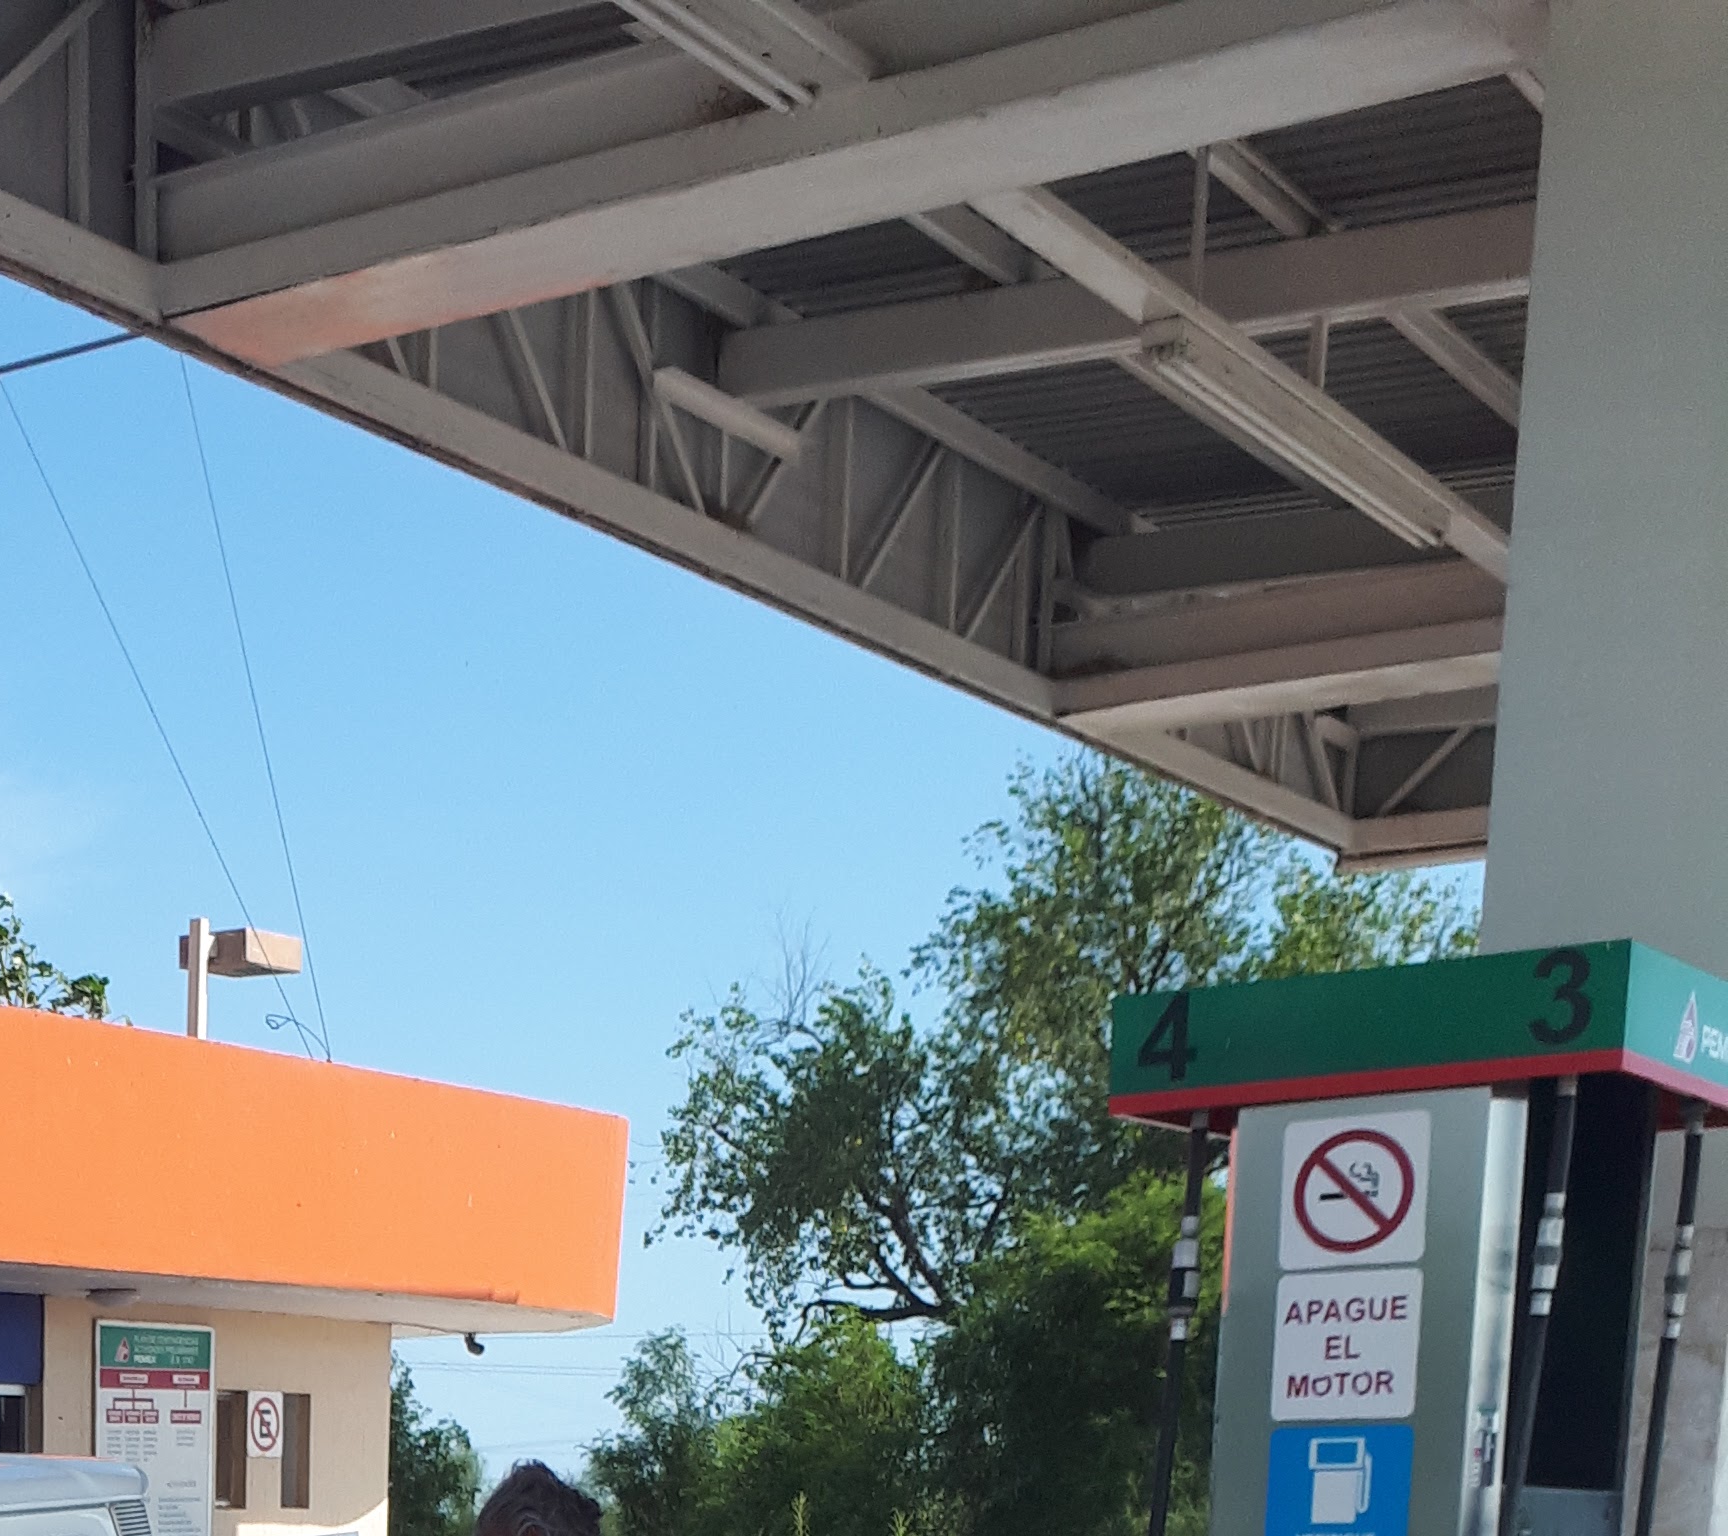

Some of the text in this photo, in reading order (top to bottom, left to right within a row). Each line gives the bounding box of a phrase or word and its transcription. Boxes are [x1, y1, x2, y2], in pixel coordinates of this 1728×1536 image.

[1529, 950, 1591, 1046] 3
[1138, 991, 1197, 1081] 4
[1283, 1295, 1409, 1325] APAGUE
[1324, 1335, 1361, 1360] EL
[1286, 1370, 1394, 1399] MOTOR
